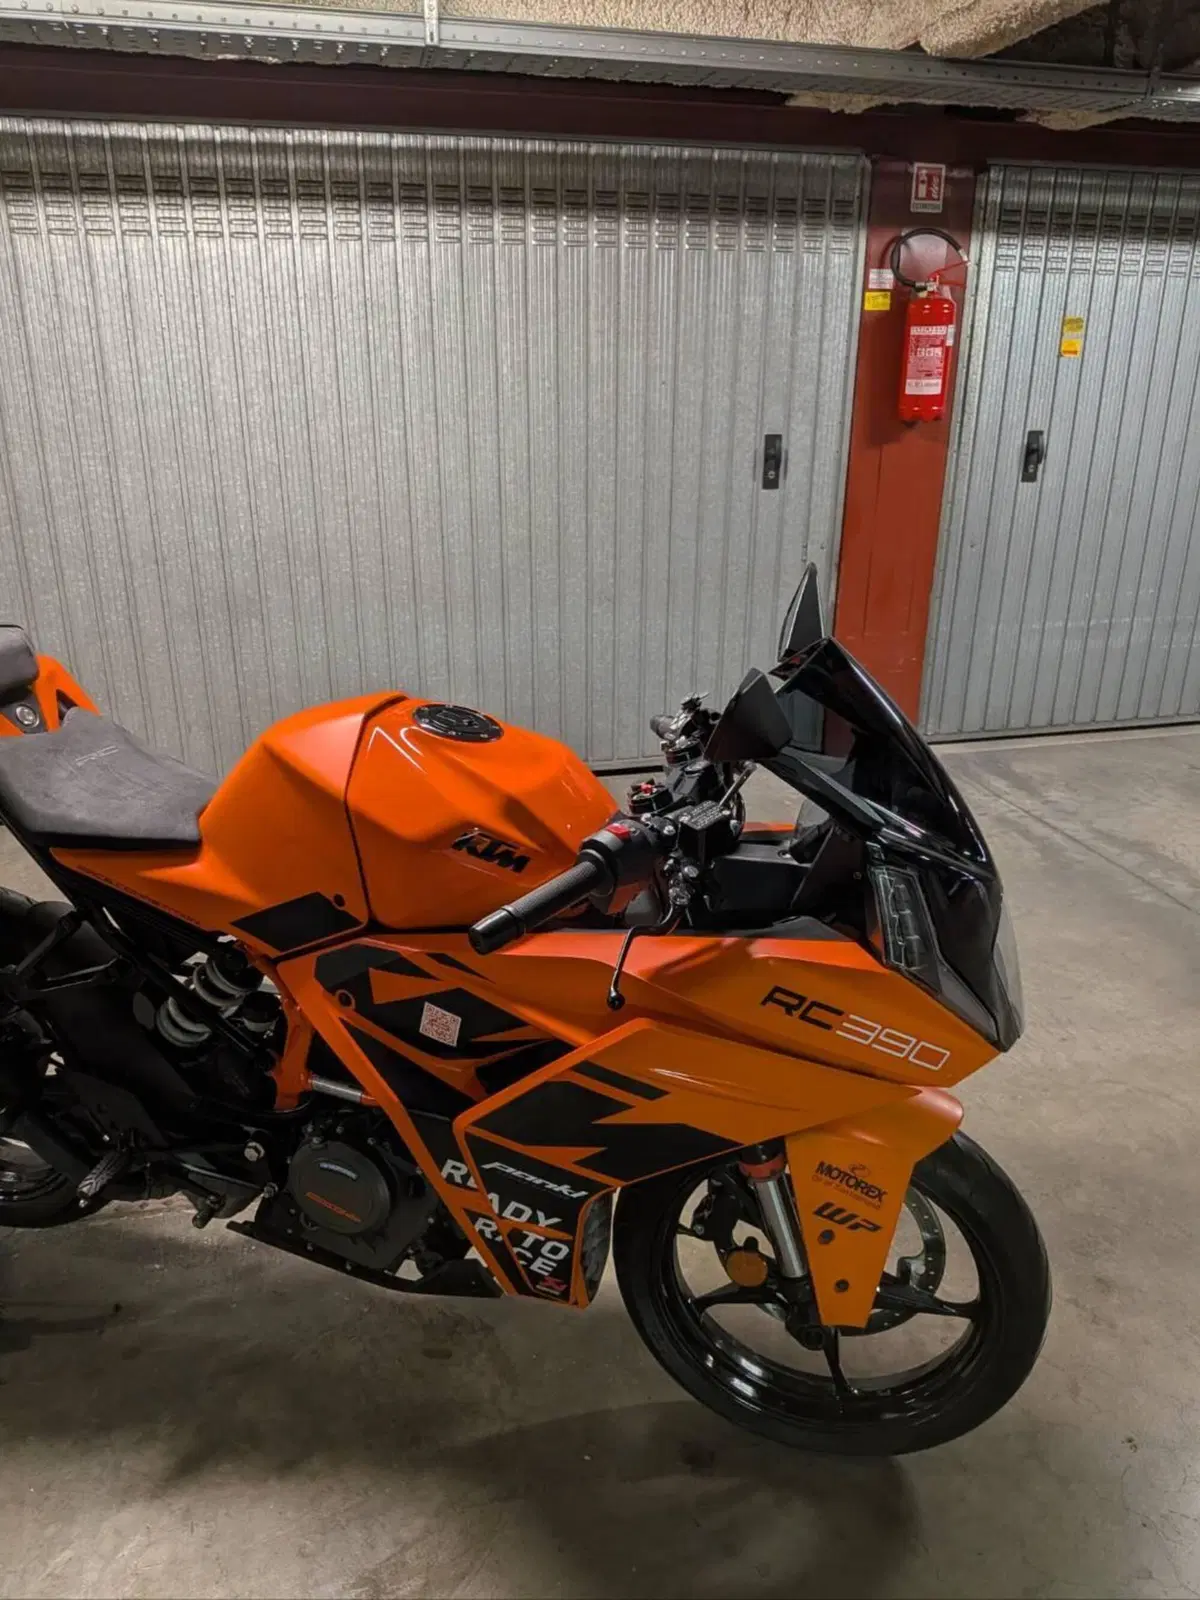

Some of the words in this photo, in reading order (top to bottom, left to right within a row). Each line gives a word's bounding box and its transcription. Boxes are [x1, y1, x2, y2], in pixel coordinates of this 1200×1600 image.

[452, 830, 531, 873] KTM
[815, 1161, 889, 1203] MOTOREX
[813, 1201, 883, 1232] WP
[523, 1230, 570, 1262] TO
